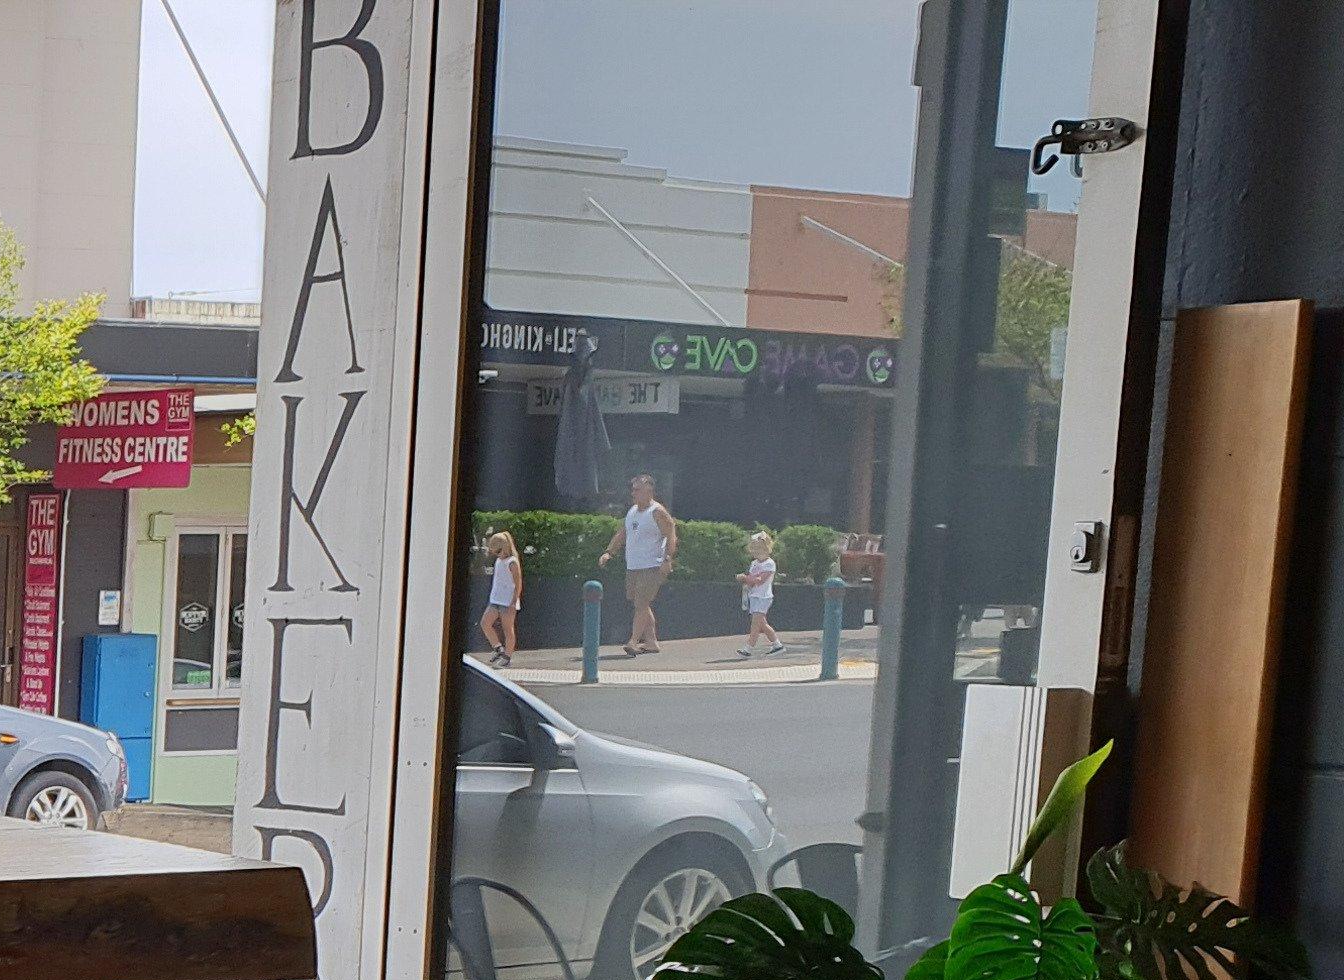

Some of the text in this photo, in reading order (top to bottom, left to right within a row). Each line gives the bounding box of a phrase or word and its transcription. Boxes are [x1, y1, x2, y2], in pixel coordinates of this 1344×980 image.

[167, 406, 190, 418] GYM
[169, 393, 191, 406] THE
[64, 399, 160, 428] WOMENS
[58, 436, 189, 464] FITNESS CENTRE
[31, 499, 56, 526] THE
[28, 528, 54, 556] GYM
